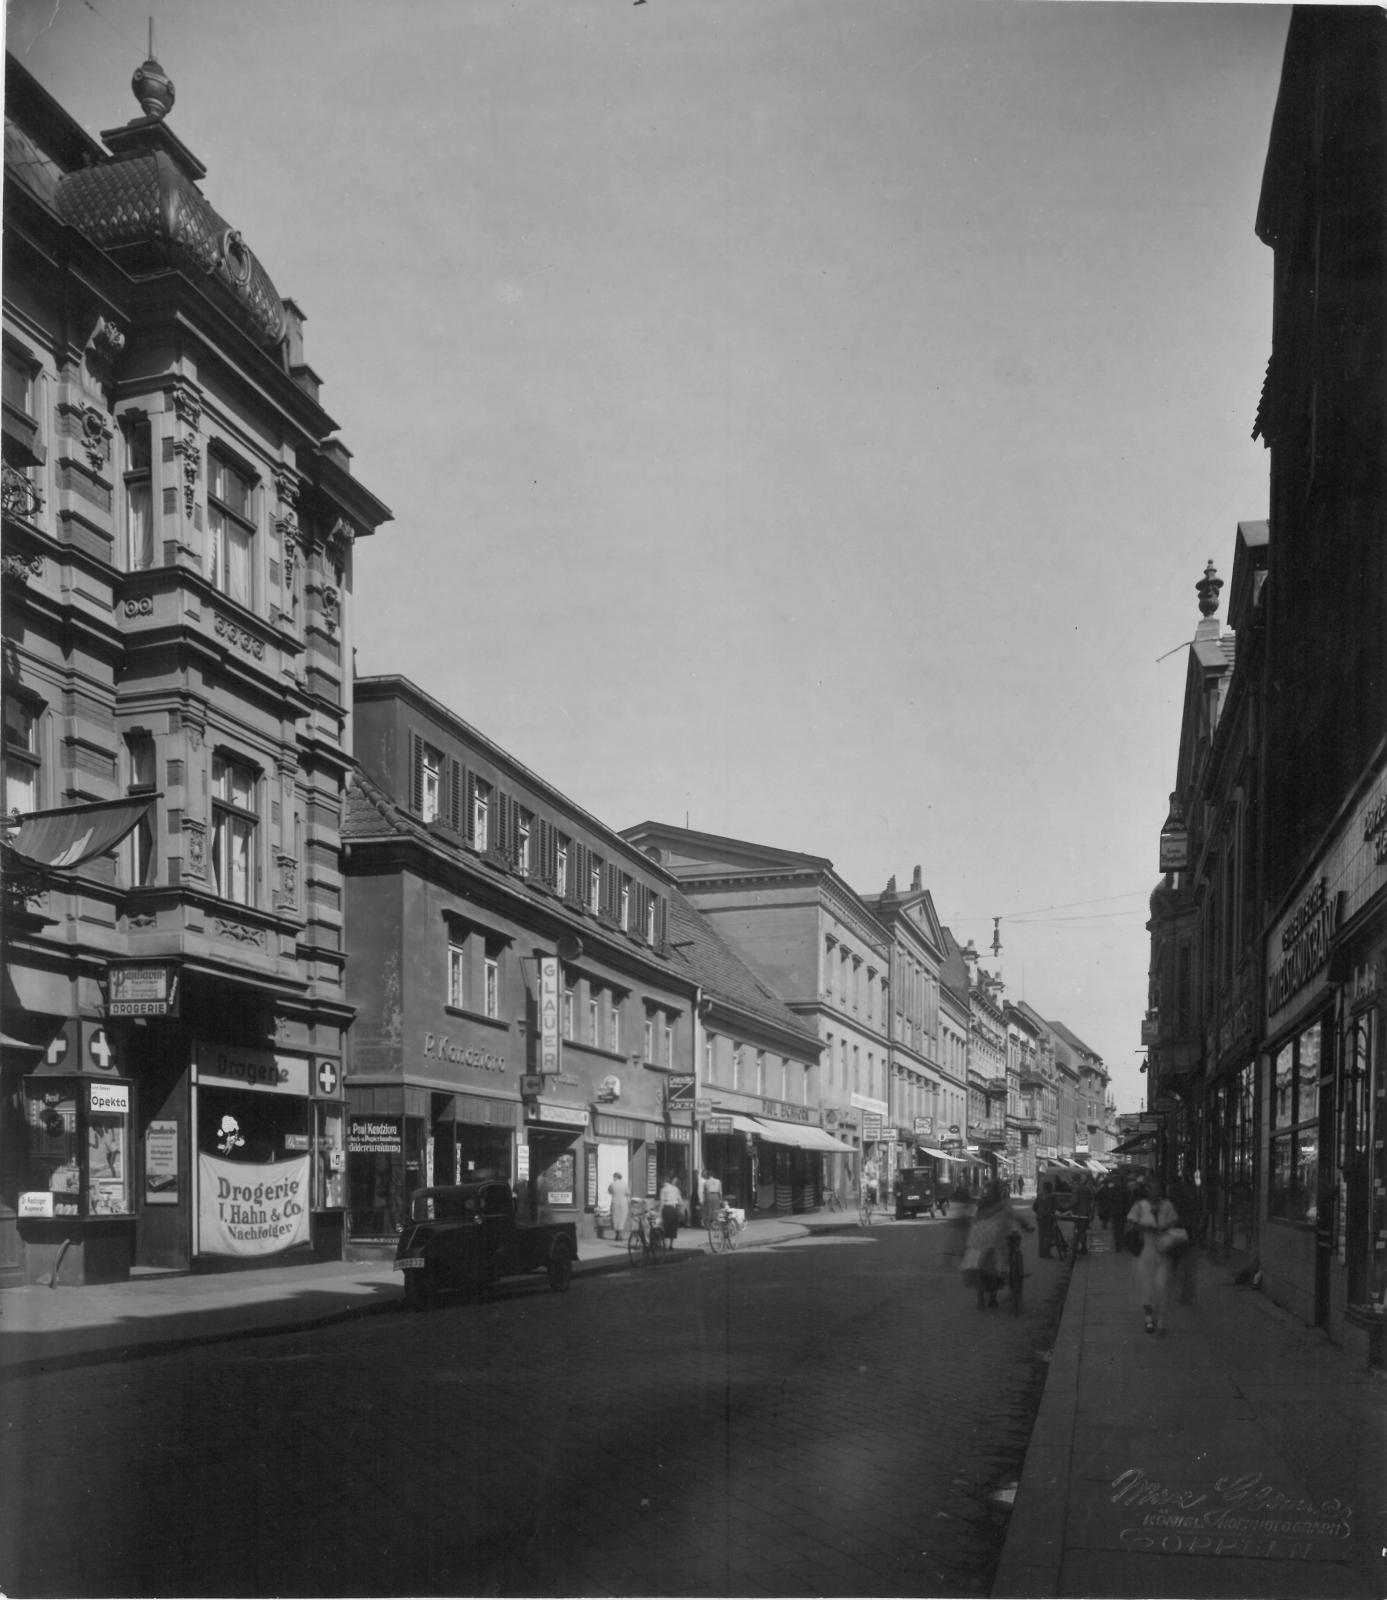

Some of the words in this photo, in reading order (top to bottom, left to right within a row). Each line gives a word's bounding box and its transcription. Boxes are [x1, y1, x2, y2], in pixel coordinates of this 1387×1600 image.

[113, 1004, 165, 1014] DROGERIE
[543, 964, 557, 1066] GLAUER
[438, 1036, 506, 1074] Kandziora
[217, 1052, 289, 1086] Drogerie
[92, 1096, 127, 1108] Opekta
[352, 1121, 367, 1135] Paul
[217, 1176, 299, 1206] Drogerie
[230, 1205, 267, 1224] Hahn
[271, 1208, 281, 1222] &
[228, 1223, 293, 1240] Nachfolger
